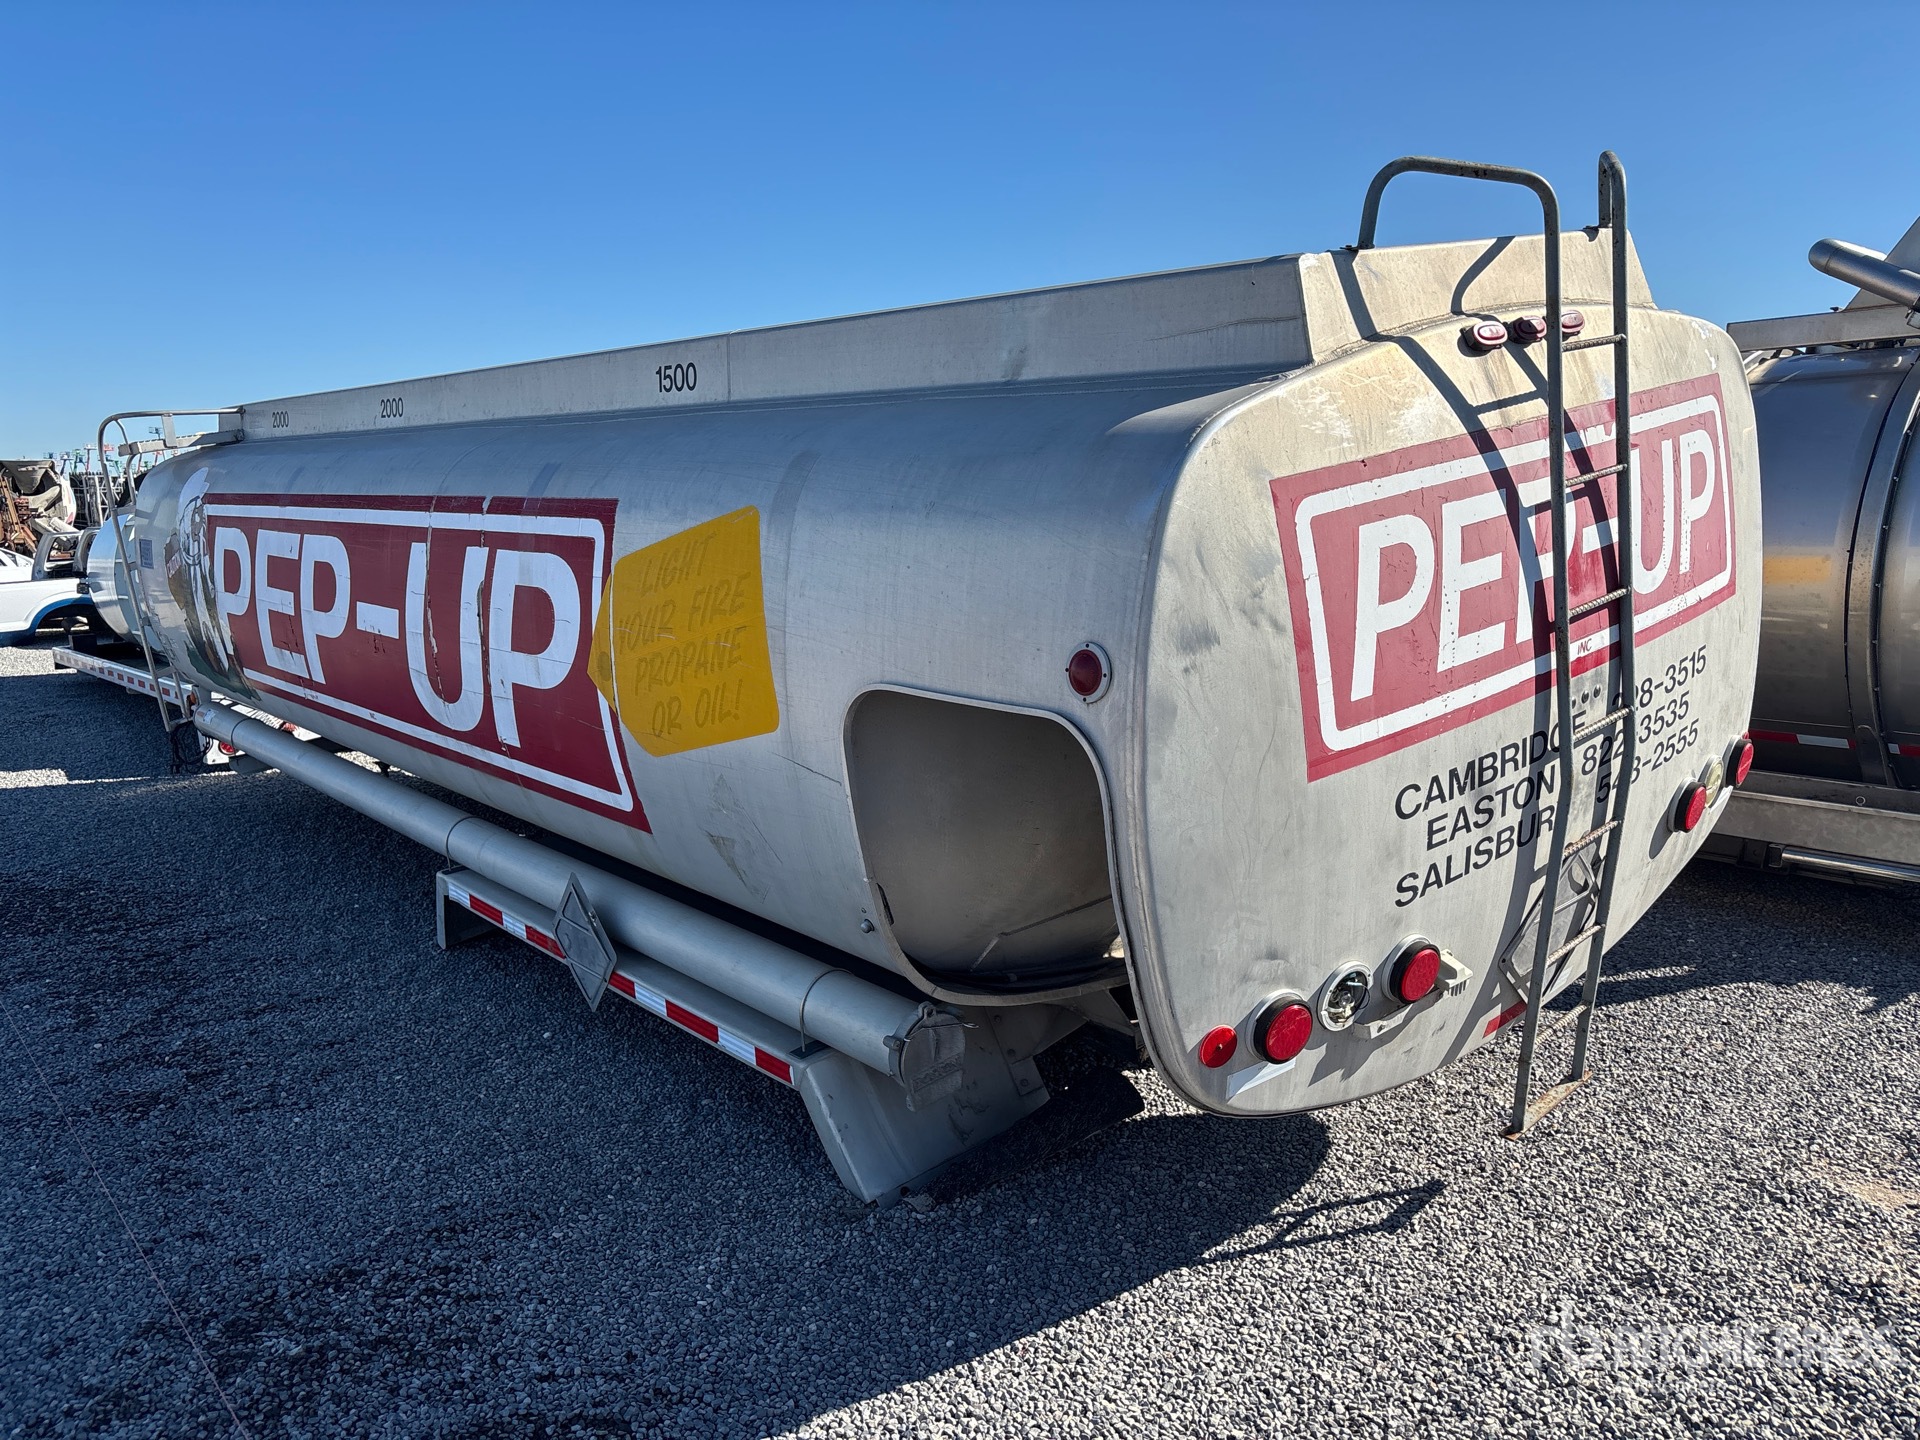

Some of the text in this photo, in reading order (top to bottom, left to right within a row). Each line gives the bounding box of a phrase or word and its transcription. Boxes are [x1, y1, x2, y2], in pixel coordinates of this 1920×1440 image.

[380, 397, 404, 419] 2000
[655, 362, 698, 393] 1500
[272, 411, 289, 428] 2000
[640, 530, 720, 598] LIGHT
[1350, 429, 1716, 702] PEP-UP
[214, 527, 581, 748] PEP-UP
[618, 571, 751, 654] YOUR FIRE
[1577, 637, 1593, 656] INC
[635, 625, 748, 697] PROPANE
[1611, 644, 1707, 712] 8-3515
[652, 679, 743, 738] OR OIL!
[1427, 690, 1690, 851] EASTON 8223535
[1395, 805, 1556, 908] SALISBUR
